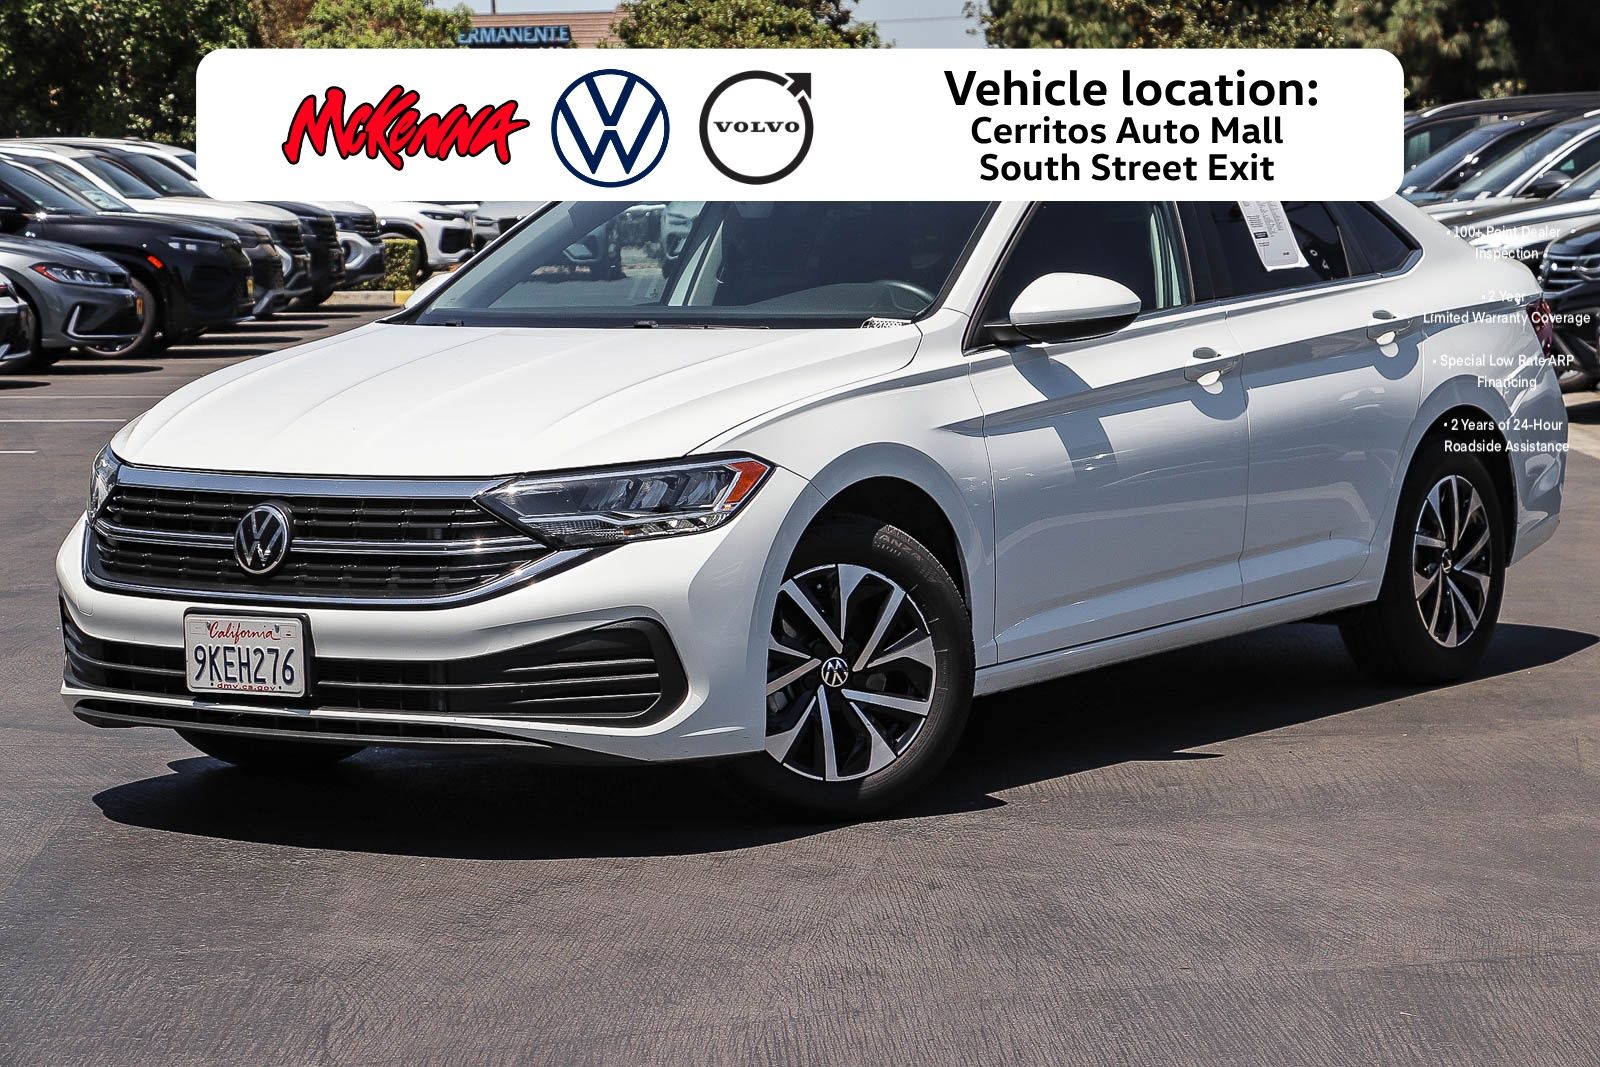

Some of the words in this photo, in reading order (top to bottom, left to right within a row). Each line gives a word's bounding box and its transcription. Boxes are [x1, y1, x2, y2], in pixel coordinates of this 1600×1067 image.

[457, 26, 570, 44] ERMANENTE
[209, 621, 281, 644] California
[194, 645, 296, 685] 9KEH276
